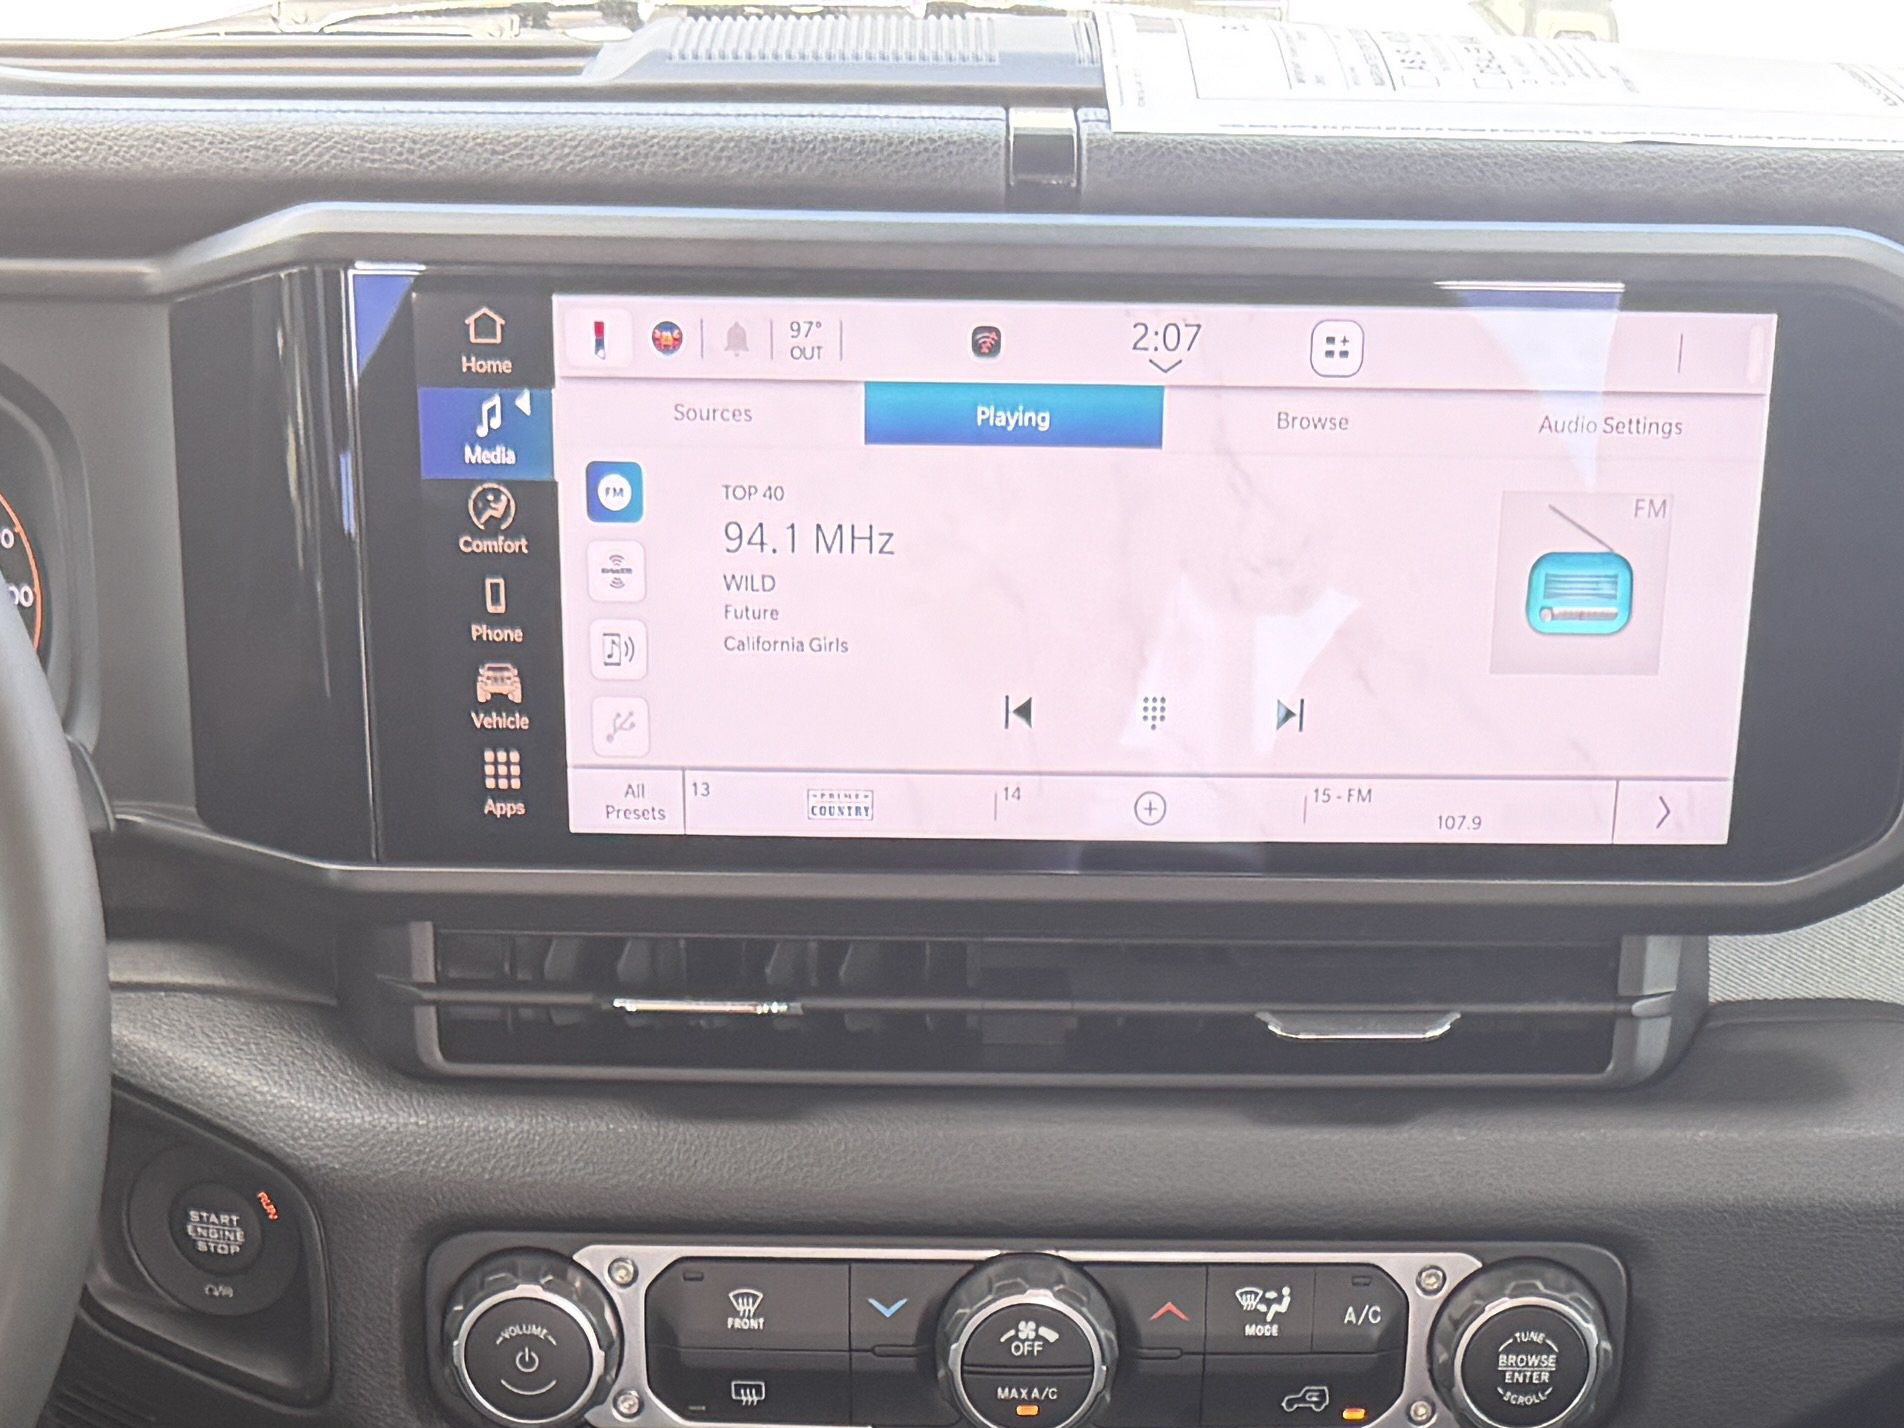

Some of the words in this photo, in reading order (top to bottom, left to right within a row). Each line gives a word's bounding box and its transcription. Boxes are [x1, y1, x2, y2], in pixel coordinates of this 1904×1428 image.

[1131, 323, 1203, 354] 2:07
[789, 345, 824, 362] OUT
[461, 354, 513, 374] Home
[673, 403, 753, 423] Sources
[976, 405, 1051, 433] Playing
[1276, 411, 1350, 432] Browse
[1538, 415, 1598, 437] Audio
[1602, 416, 1684, 440] Settings
[464, 443, 517, 464] Media
[722, 485, 763, 501] TOP
[765, 485, 785, 501] 40
[1633, 498, 1668, 519] FM
[458, 535, 529, 555] Comfort
[723, 523, 799, 556] 94.1
[815, 523, 896, 556] MHz
[723, 575, 777, 593] WILD
[723, 604, 780, 622] Future
[471, 622, 523, 645] Phone
[723, 636, 805, 654] California
[808, 636, 849, 655] Girls
[470, 710, 529, 731] Vehicle
[625, 781, 646, 800] All
[692, 781, 710, 798] 13
[1003, 786, 1021, 803] 14
[1312, 788, 1333, 804] 15
[1346, 789, 1373, 805] FM
[484, 799, 526, 820] Apps
[605, 804, 667, 824] Presets
[811, 805, 870, 817] COUNTRY
[1437, 814, 1482, 832] 107.9
[189, 1210, 240, 1226] START
[187, 1224, 245, 1243] ENGINE
[196, 1241, 241, 1255] STOP
[727, 1317, 765, 1330] FRONT
[1343, 1305, 1382, 1325] A/C
[501, 1323, 548, 1340] VOLUME
[1245, 1324, 1279, 1337] MODE
[1513, 1332, 1546, 1345] TUNE
[1011, 1341, 1043, 1357] OFF
[1498, 1353, 1557, 1368] BROWSE
[1504, 1371, 1550, 1385] ENTER
[997, 1386, 1029, 1400] MAX
[1031, 1387, 1058, 1400] A/C
[1502, 1390, 1549, 1406] SCROLL
